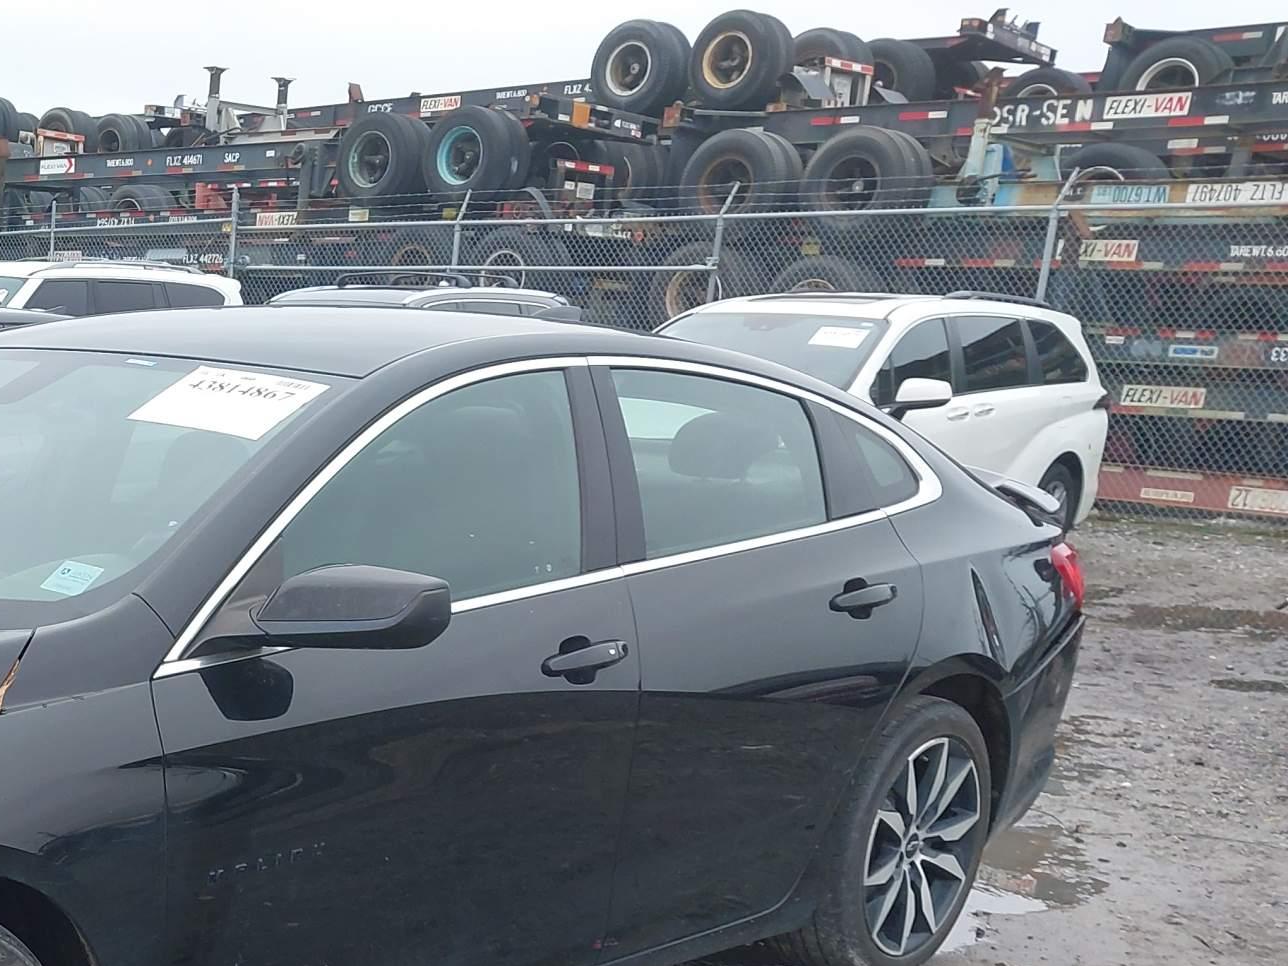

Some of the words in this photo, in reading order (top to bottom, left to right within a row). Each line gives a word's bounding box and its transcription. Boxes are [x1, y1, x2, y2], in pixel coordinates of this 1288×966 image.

[421, 96, 461, 110] FLEXI-VAN
[1106, 95, 1187, 116] FLEXI-VAN
[166, 155, 182, 166] FLXZ
[189, 379, 296, 401] 43814867
[1124, 388, 1202, 406] FLEXI-VAN
